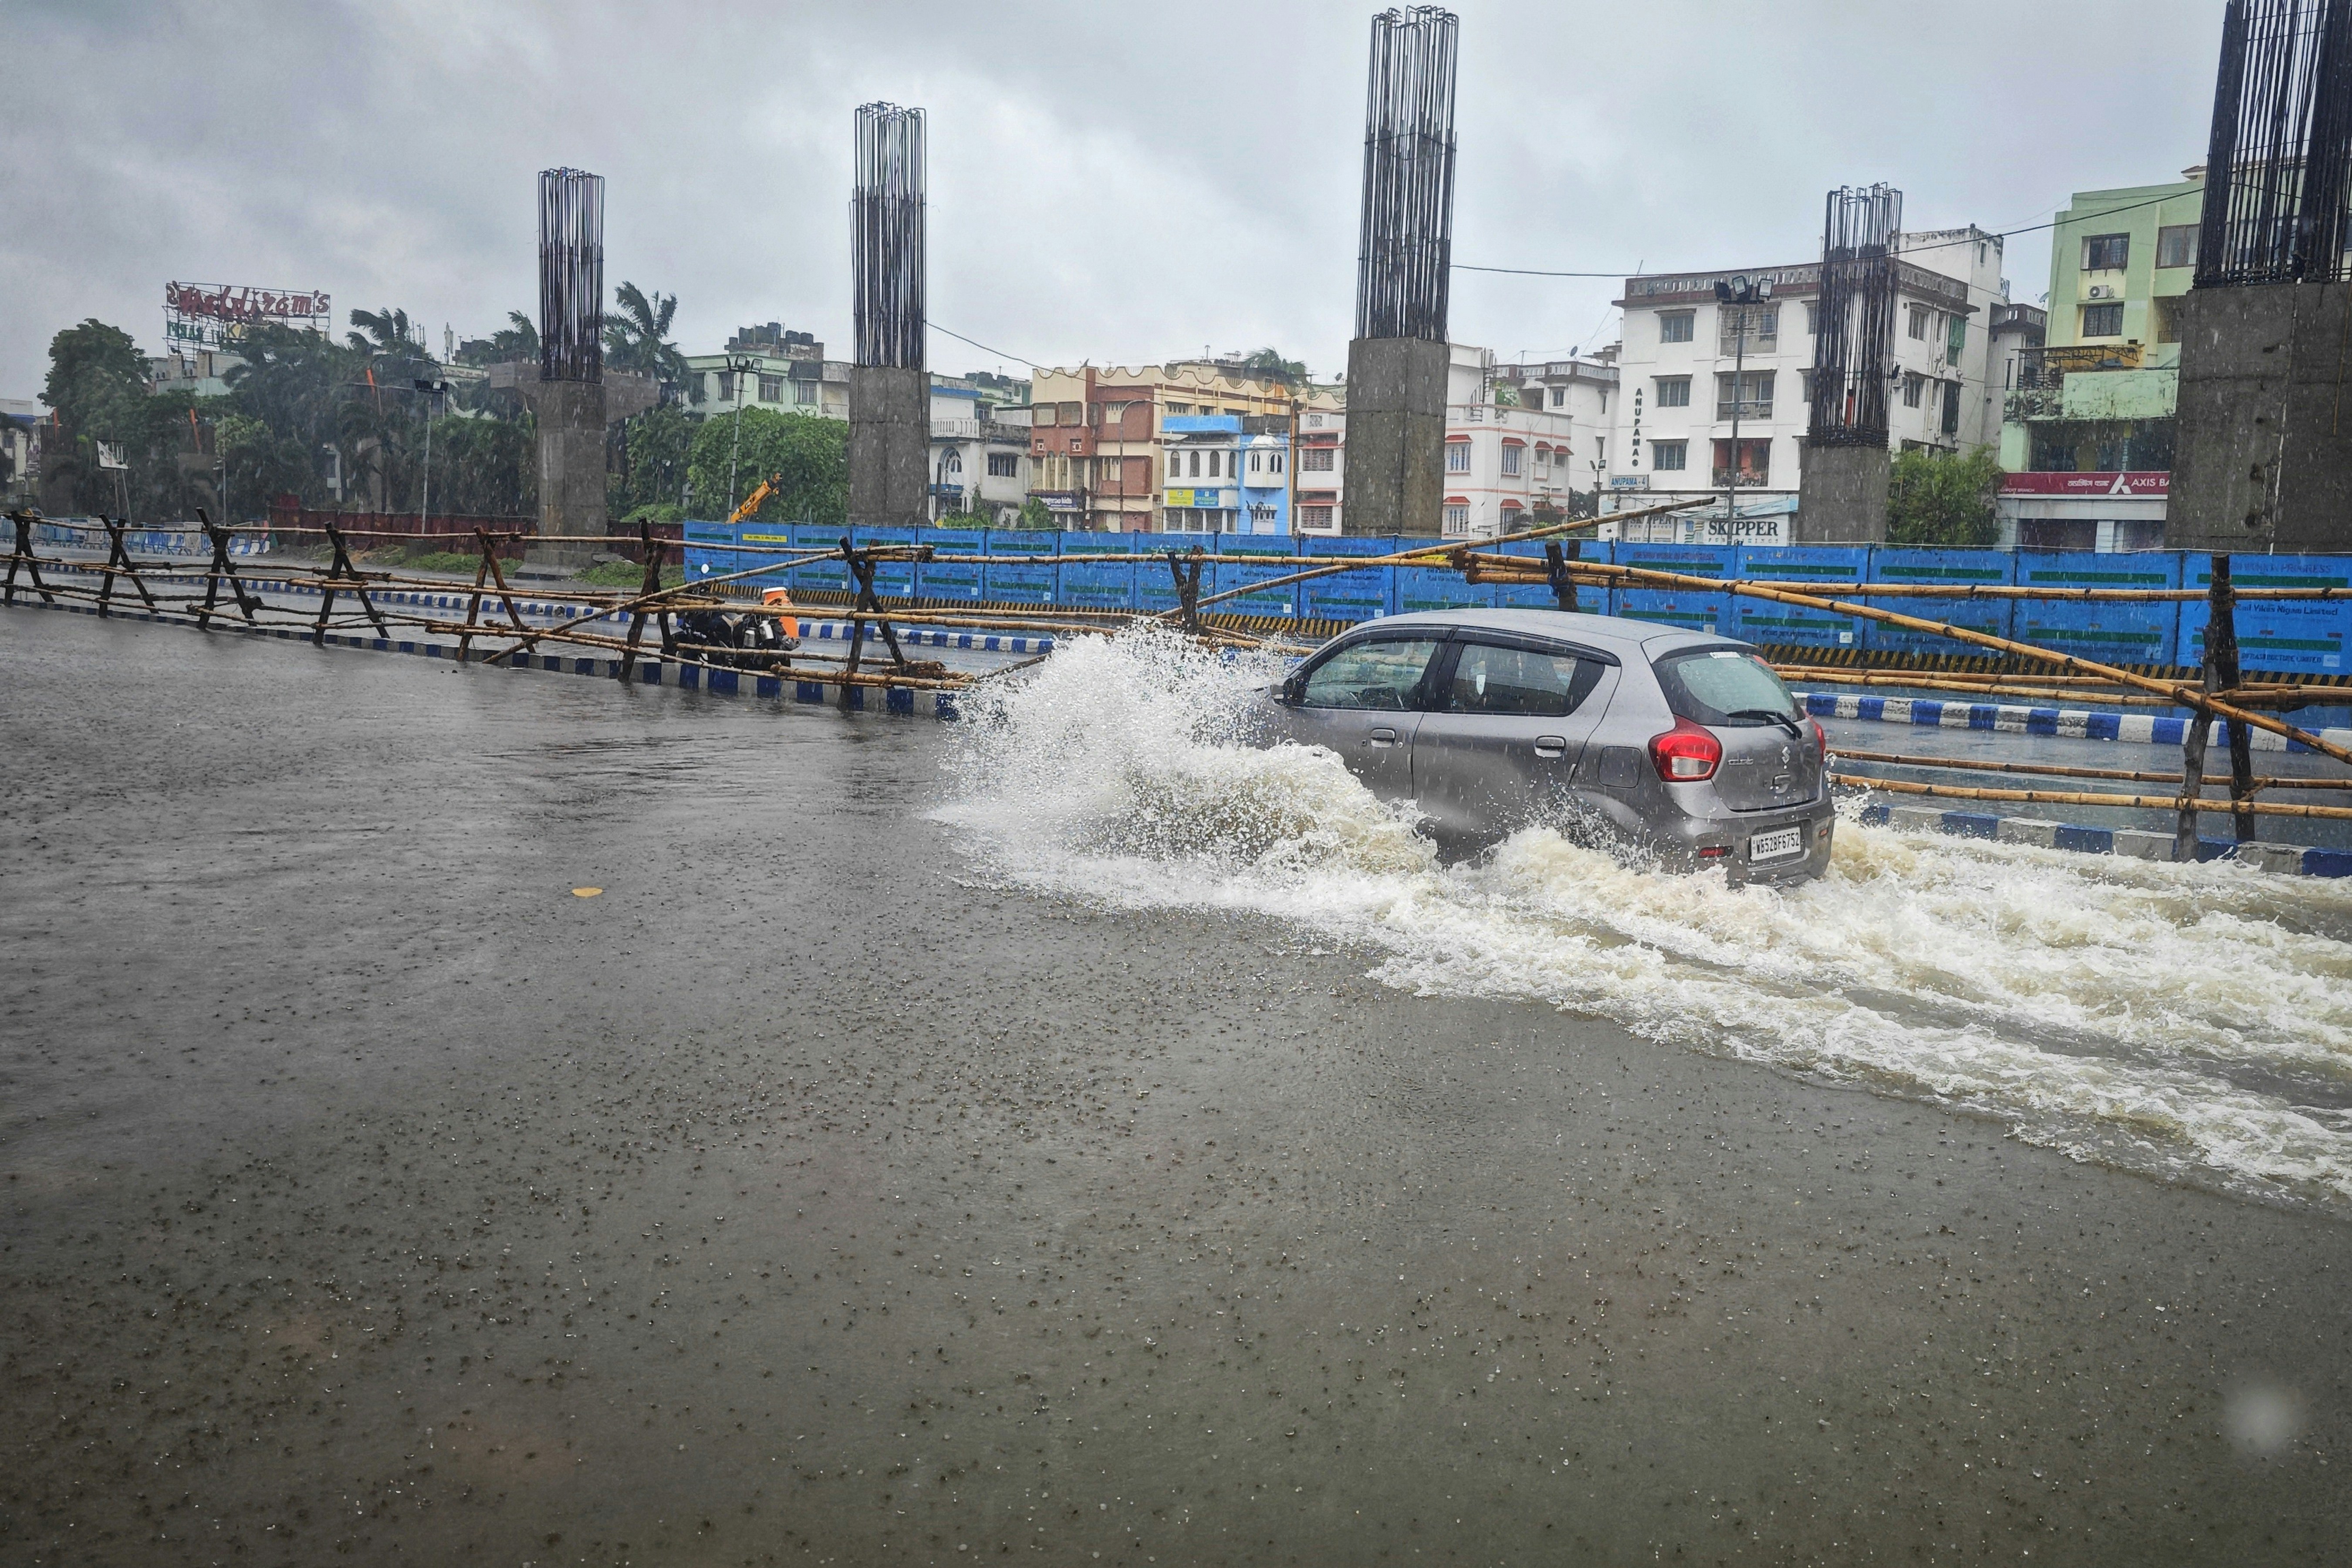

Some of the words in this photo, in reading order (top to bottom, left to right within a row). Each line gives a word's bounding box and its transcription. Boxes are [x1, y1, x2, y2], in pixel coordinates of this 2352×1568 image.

[1632, 388, 1642, 456] ANUPAMA
[1611, 477, 1637, 485] ANUPAMA
[2131, 478, 2156, 487] AXIS
[1757, 832, 1799, 854] WB52BF6752
